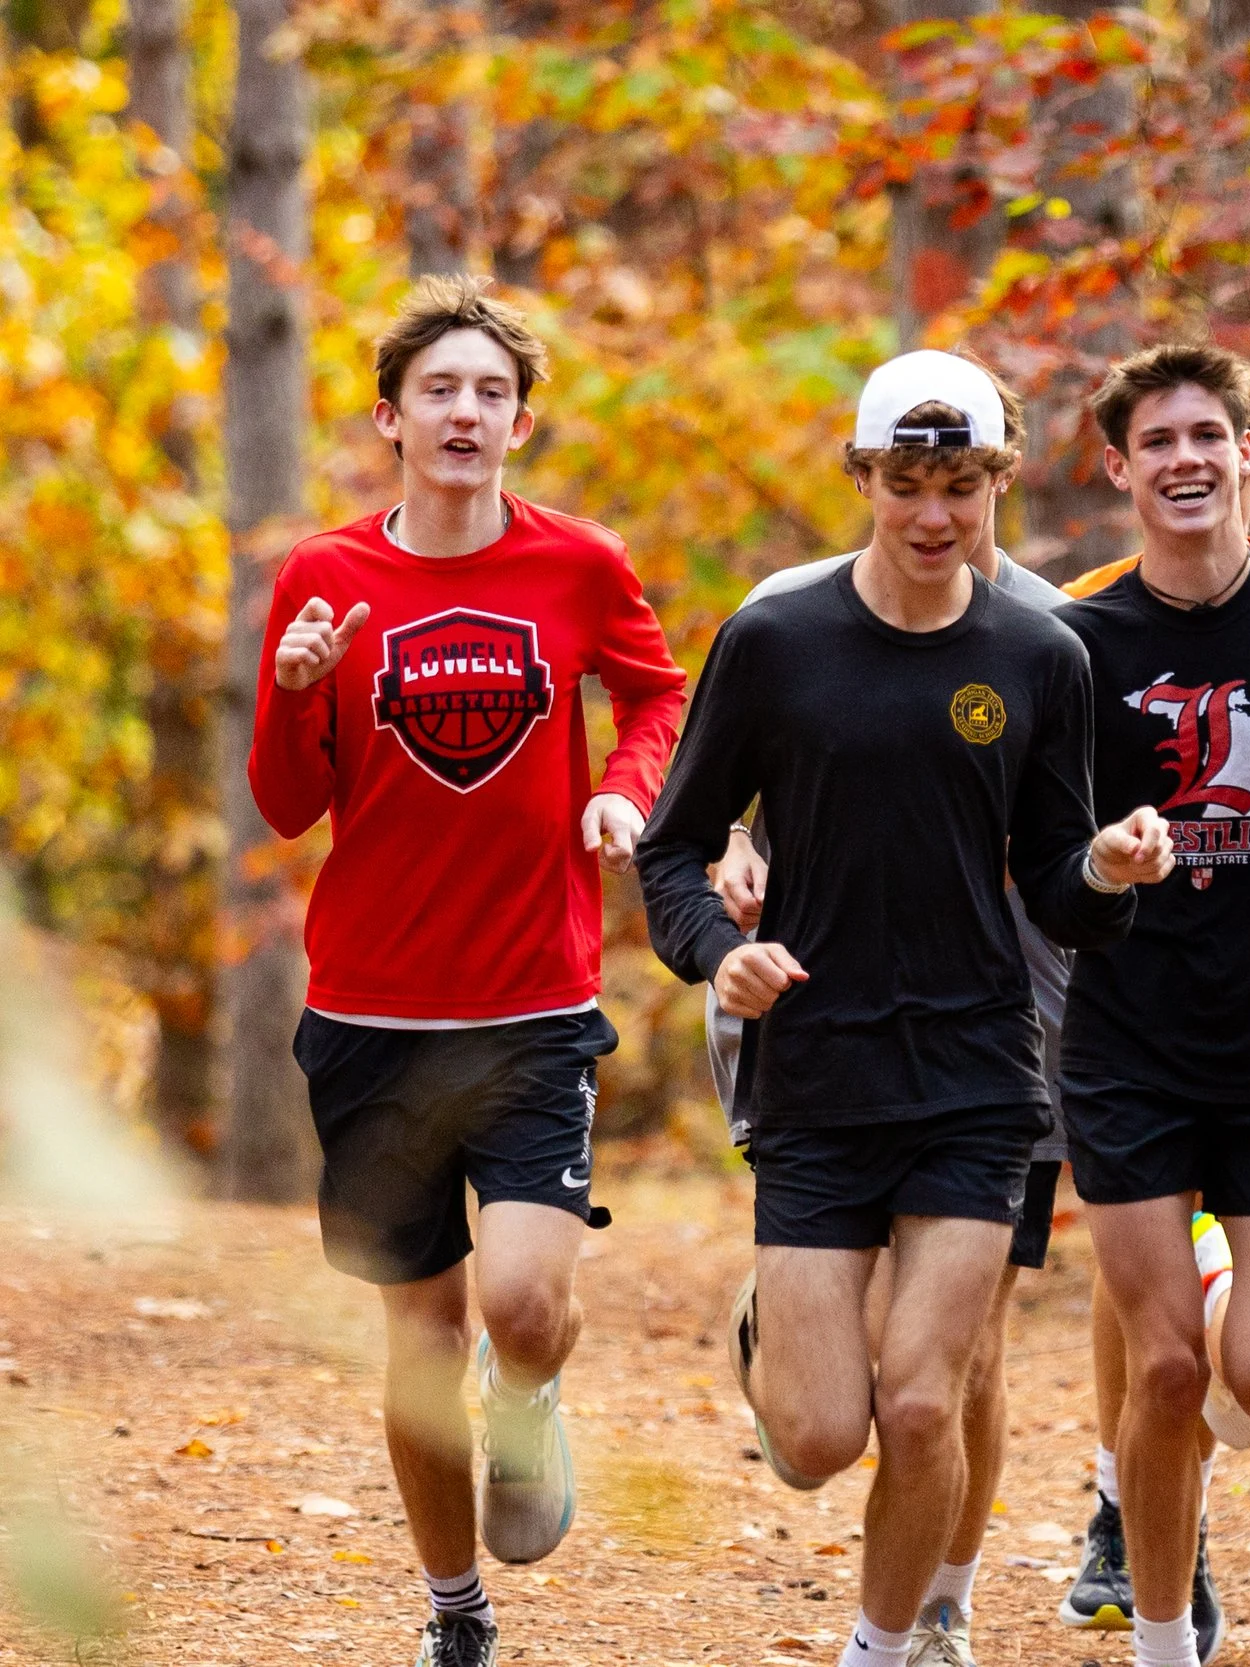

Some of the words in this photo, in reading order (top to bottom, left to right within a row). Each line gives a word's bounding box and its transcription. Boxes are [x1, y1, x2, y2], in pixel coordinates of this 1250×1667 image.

[403, 642, 523, 683] LOWELL
[388, 692, 539, 716] BASKETBALL
[1186, 856, 1213, 866] TEAM
[1216, 855, 1248, 865] STATE
